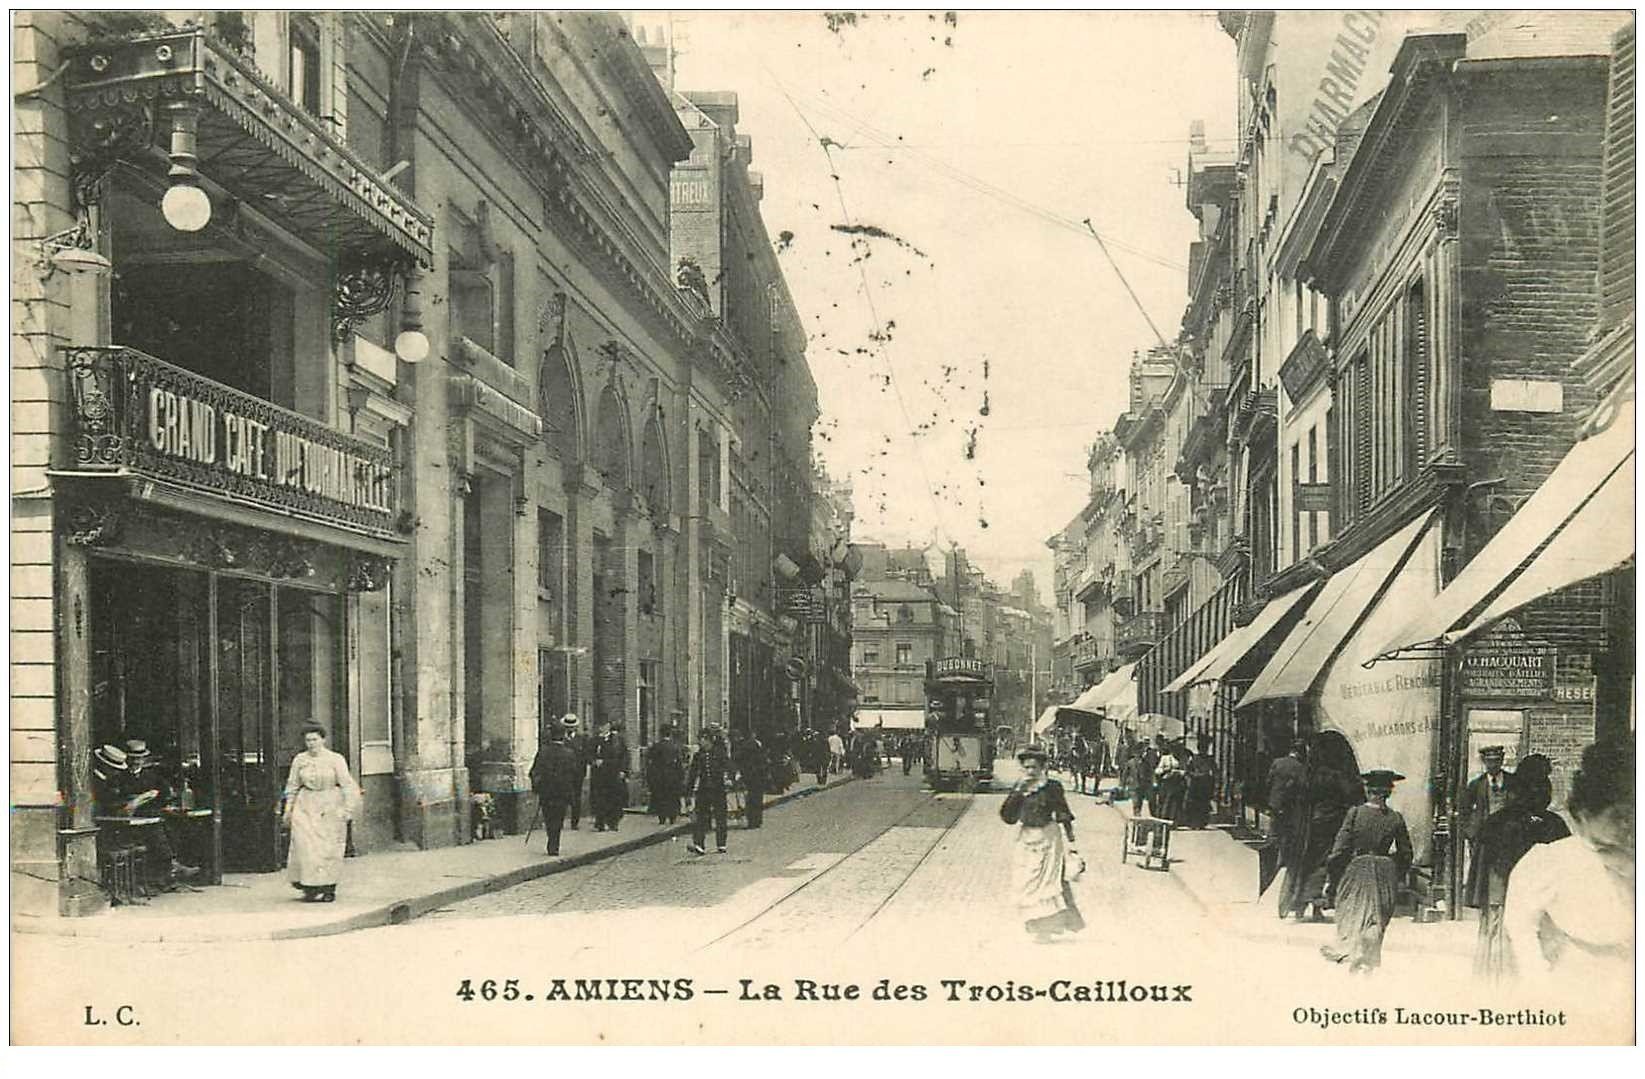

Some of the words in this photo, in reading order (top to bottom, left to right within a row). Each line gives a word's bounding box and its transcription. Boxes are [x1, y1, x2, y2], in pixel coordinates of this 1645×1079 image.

[149, 387, 217, 463] GRAND
[936, 659, 983, 673] DUBONNET
[1481, 656, 1544, 670] HACQUART
